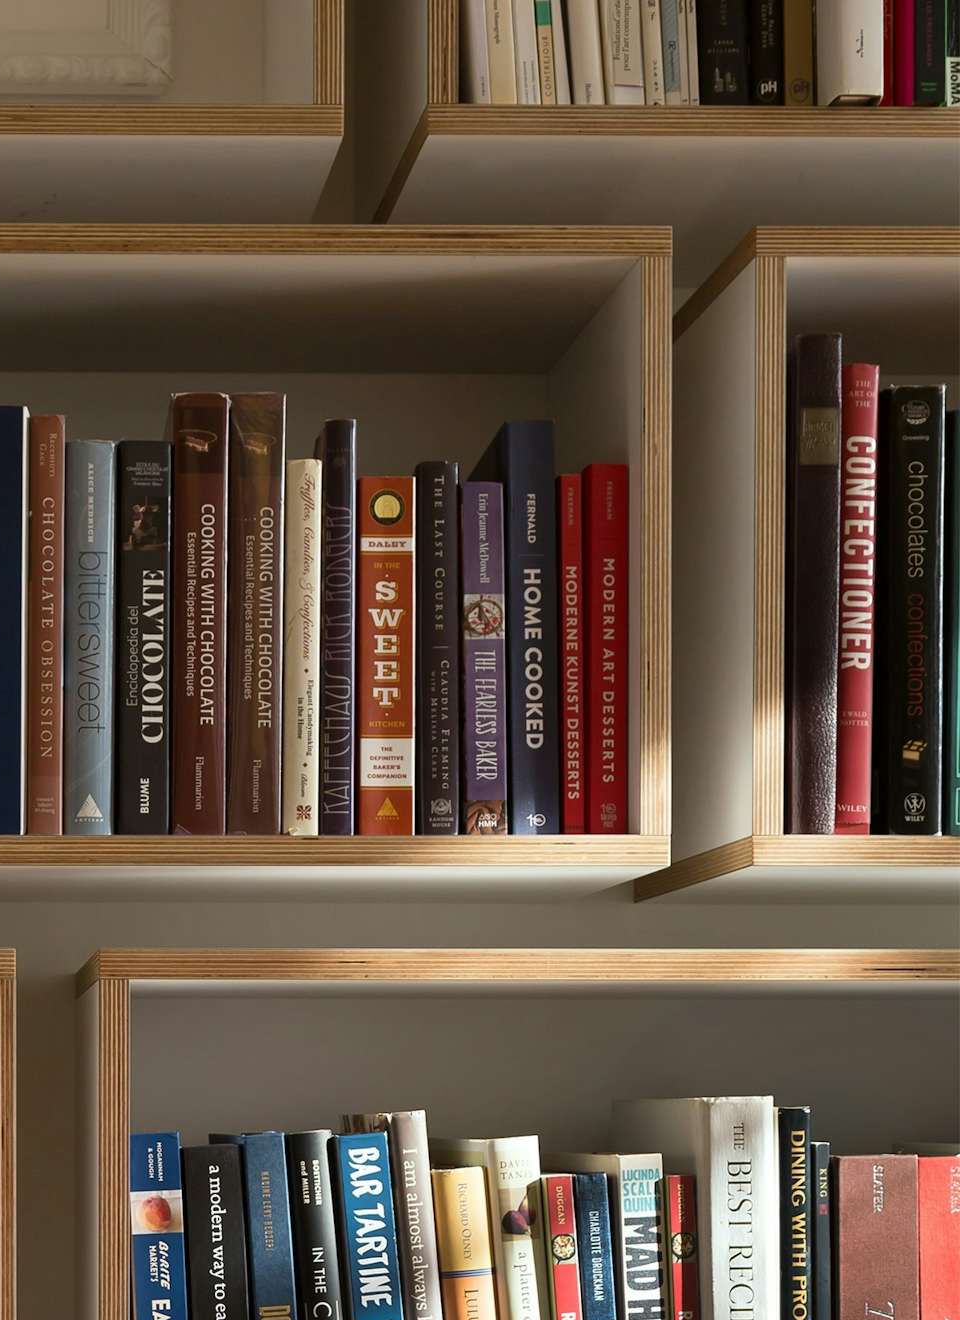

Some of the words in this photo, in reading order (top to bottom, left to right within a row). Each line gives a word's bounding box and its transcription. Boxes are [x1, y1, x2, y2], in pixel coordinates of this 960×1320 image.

[950, 60, 960, 105] MoMA
[434, 475, 445, 508] THE
[478, 493, 489, 511] Erin
[527, 493, 537, 544] FERNALD
[200, 503, 215, 579] COOKING
[259, 506, 274, 581] COOKING
[434, 519, 445, 557] LAST
[476, 511, 489, 541] Jeanne
[907, 461, 929, 578] chocolates
[41, 496, 55, 629] CHOCOLATE
[186, 532, 197, 577] Essential
[323, 503, 352, 603] RODGERS
[373, 562, 384, 570] IN
[384, 562, 401, 570] THE
[478, 542, 490, 583] McDowell
[841, 435, 877, 670] CONFECTIONER
[126, 605, 139, 625] del
[186, 579, 197, 617] Recipes
[200, 583, 215, 625] WITH
[258, 586, 273, 628] WITH
[434, 567, 446, 631] COURSE
[523, 567, 542, 640] HOME
[565, 566, 578, 650] MODERNE
[602, 558, 615, 641] MODERN
[77, 551, 107, 735] bittersweet
[186, 619, 196, 638] and
[323, 612, 352, 661] RICK
[368, 580, 404, 708] SWEET
[906, 592, 928, 717] confections
[126, 628, 140, 706] Enciclopedia
[141, 569, 165, 744] CHOCOLATE
[185, 639, 197, 697] Techniques
[200, 630, 215, 725] CHOCOLATE
[257, 633, 273, 728] CHOCOLATE
[474, 649, 496, 673] THE
[602, 648, 615, 683] ART
[41, 639, 54, 758] OBSESSION
[440, 659, 451, 720] CLAUDIA
[474, 678, 497, 735] FEARLESS
[524, 647, 544, 749] COOKED
[566, 655, 579, 713] KUNST
[323, 671, 352, 815] KAFFEEHAUS
[368, 720, 406, 728] KITCHEN
[602, 691, 615, 783] DESSERTS
[194, 756, 205, 810] Flammarion
[251, 759, 262, 813] Flammarion
[440, 729, 451, 790] FLEMING
[475, 741, 498, 781] BAKER
[567, 718, 580, 800] DESSERTS
[139, 777, 150, 814] BLUME
[156, 1141, 164, 1182] MOGANNAM
[733, 1123, 745, 1151] THE
[209, 1165, 220, 1174] a
[348, 1146, 384, 1198] BAR
[403, 1160, 419, 1188] am
[622, 1168, 660, 1182] LUCINDA
[727, 1159, 753, 1232] BEST
[791, 1130, 807, 1207] DINING
[819, 1168, 828, 1197] KING
[872, 1165, 884, 1213] SLATER
[949, 1166, 960, 1214] SLATER
[209, 1177, 227, 1243] modern
[406, 1192, 424, 1250] almost
[589, 1210, 602, 1254] CHARLOTTE
[209, 1245, 225, 1281] way
[311, 1246, 324, 1263] IN
[353, 1202, 393, 1308] TARTINE
[623, 1216, 663, 1291] MAD
[792, 1211, 808, 1268] WITH
[214, 1282, 227, 1299] to
[313, 1267, 326, 1293] THE
[410, 1255, 429, 1310] always
[513, 1264, 531, 1311] platter
[592, 1257, 605, 1301] DRUCKMAN
